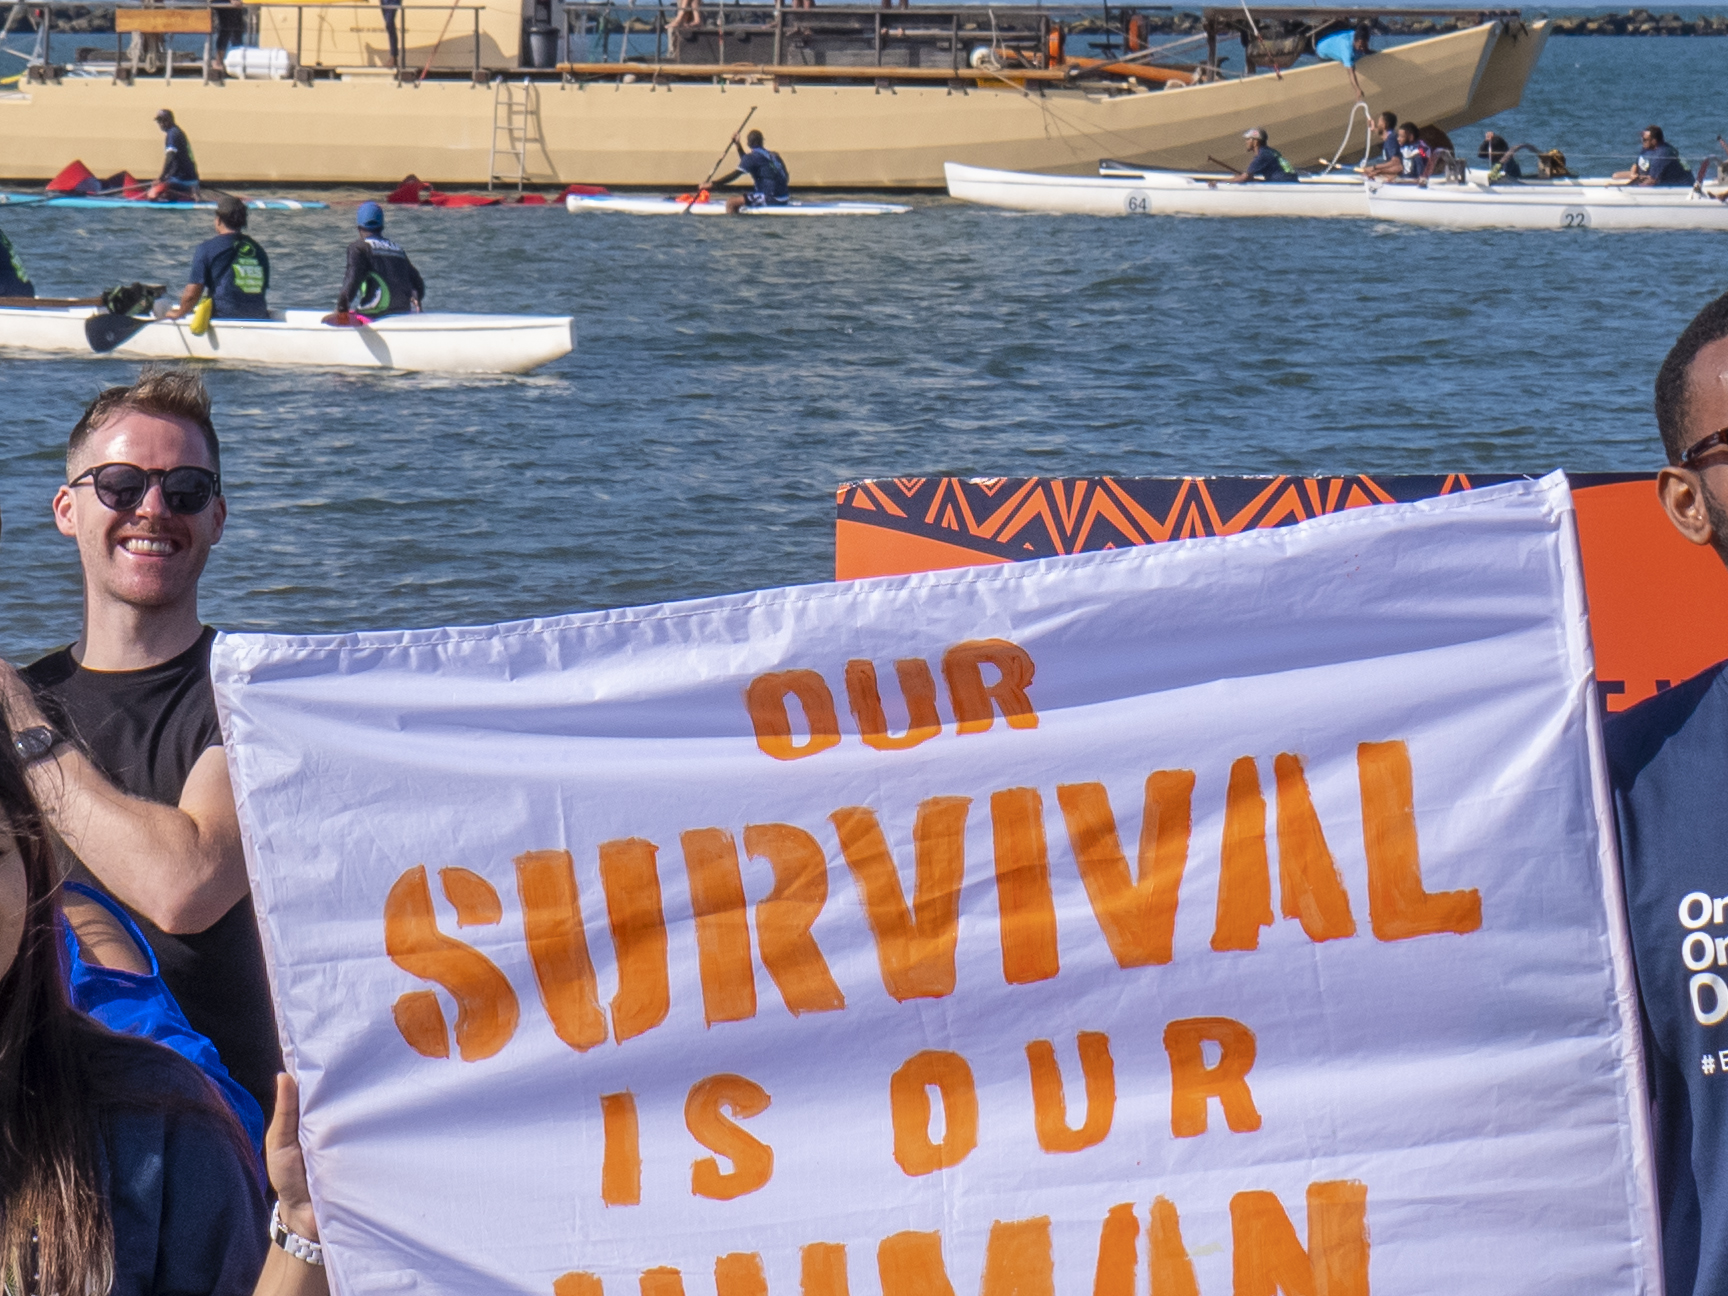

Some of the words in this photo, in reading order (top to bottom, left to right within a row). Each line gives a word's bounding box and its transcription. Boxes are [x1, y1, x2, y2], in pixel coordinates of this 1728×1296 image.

[1128, 196, 1147, 212] 64
[1565, 212, 1585, 227] 22
[743, 637, 1040, 761] OUR
[382, 739, 1483, 1062] SURVIVAL
[596, 1072, 775, 1209] IS
[889, 1016, 1263, 1178] OUR
